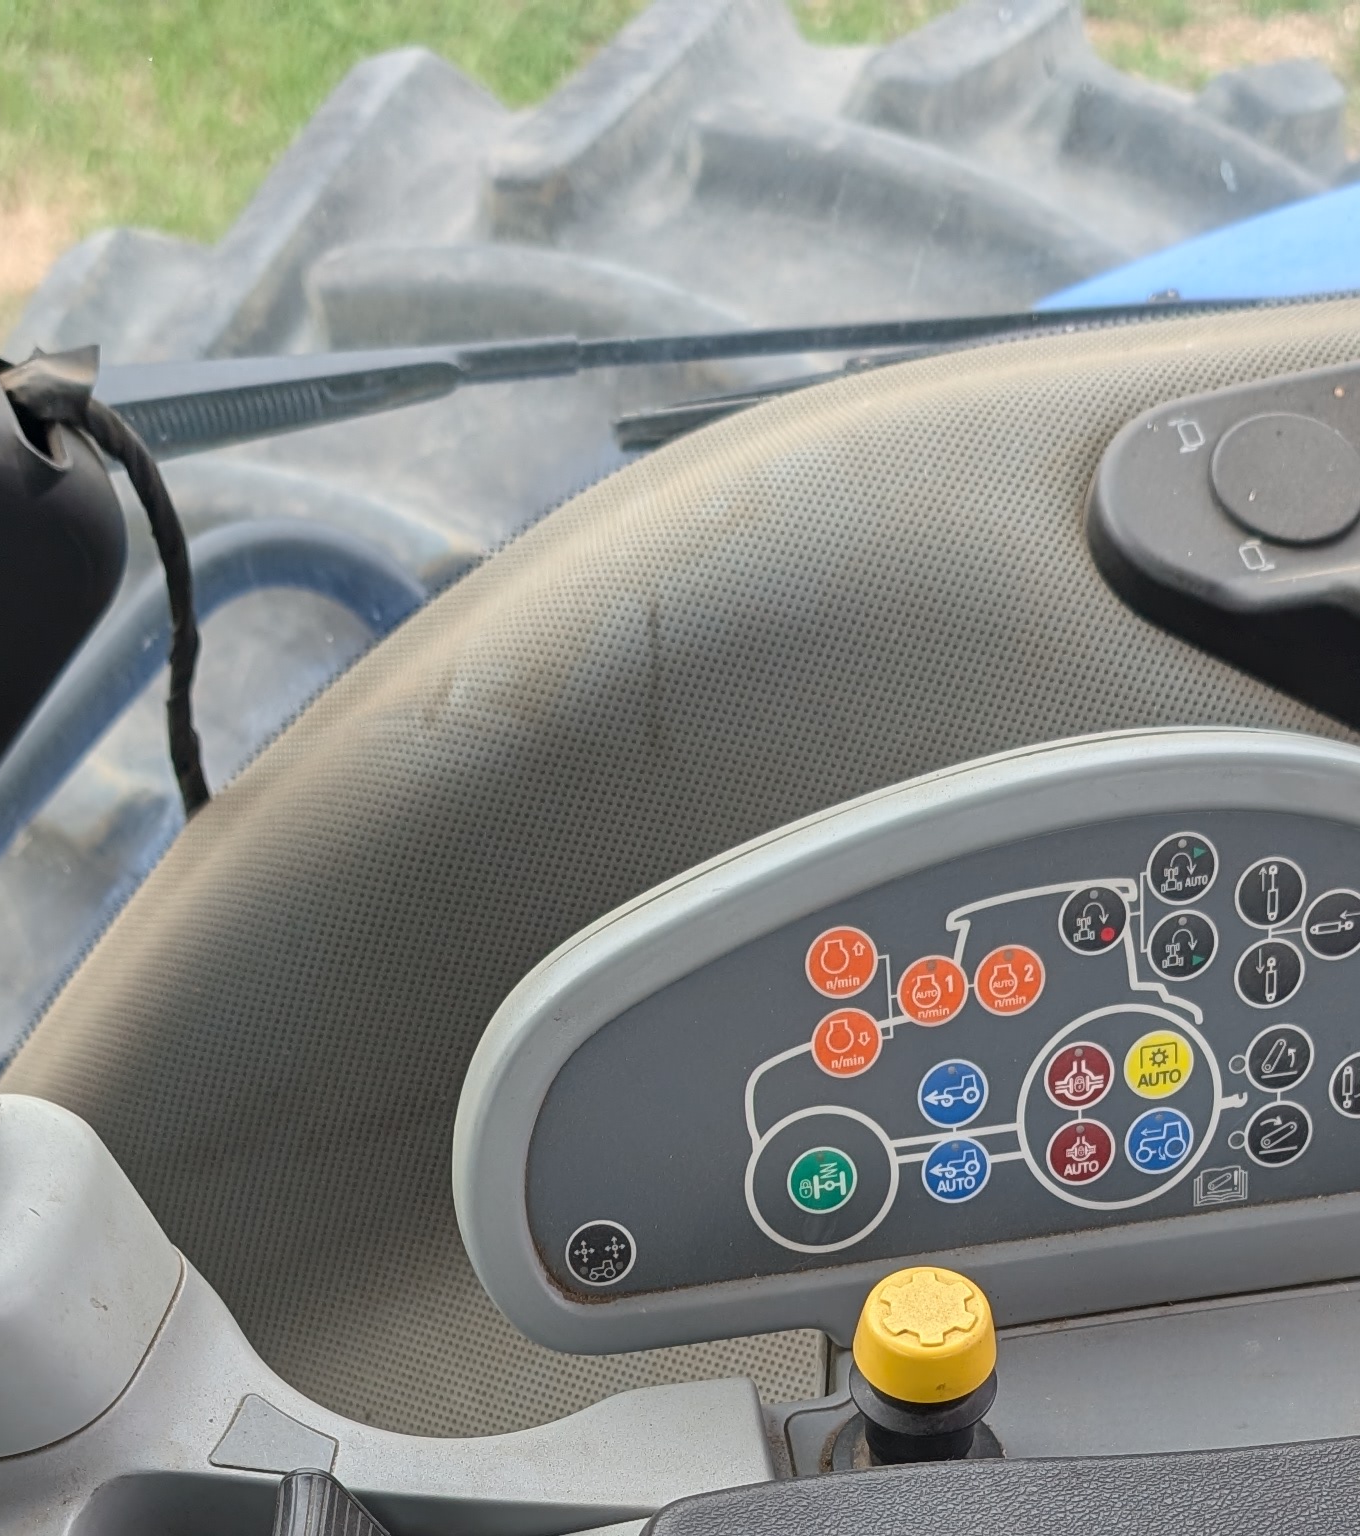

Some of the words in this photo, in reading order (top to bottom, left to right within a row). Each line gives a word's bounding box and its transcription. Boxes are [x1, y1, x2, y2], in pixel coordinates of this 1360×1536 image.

[1185, 874, 1208, 887] AUTO
[1023, 964, 1034, 982] 2
[826, 975, 860, 991] n/min
[945, 975, 954, 993] 1
[992, 979, 1015, 989] AUTO
[915, 989, 938, 1000] AUTO
[994, 995, 1027, 1008] n/min
[917, 1006, 950, 1019] n/min
[831, 1054, 865, 1069] n/min
[1137, 1069, 1182, 1089] AUTO
[1063, 1160, 1100, 1176] AUTO
[936, 1176, 976, 1193] AUTO
